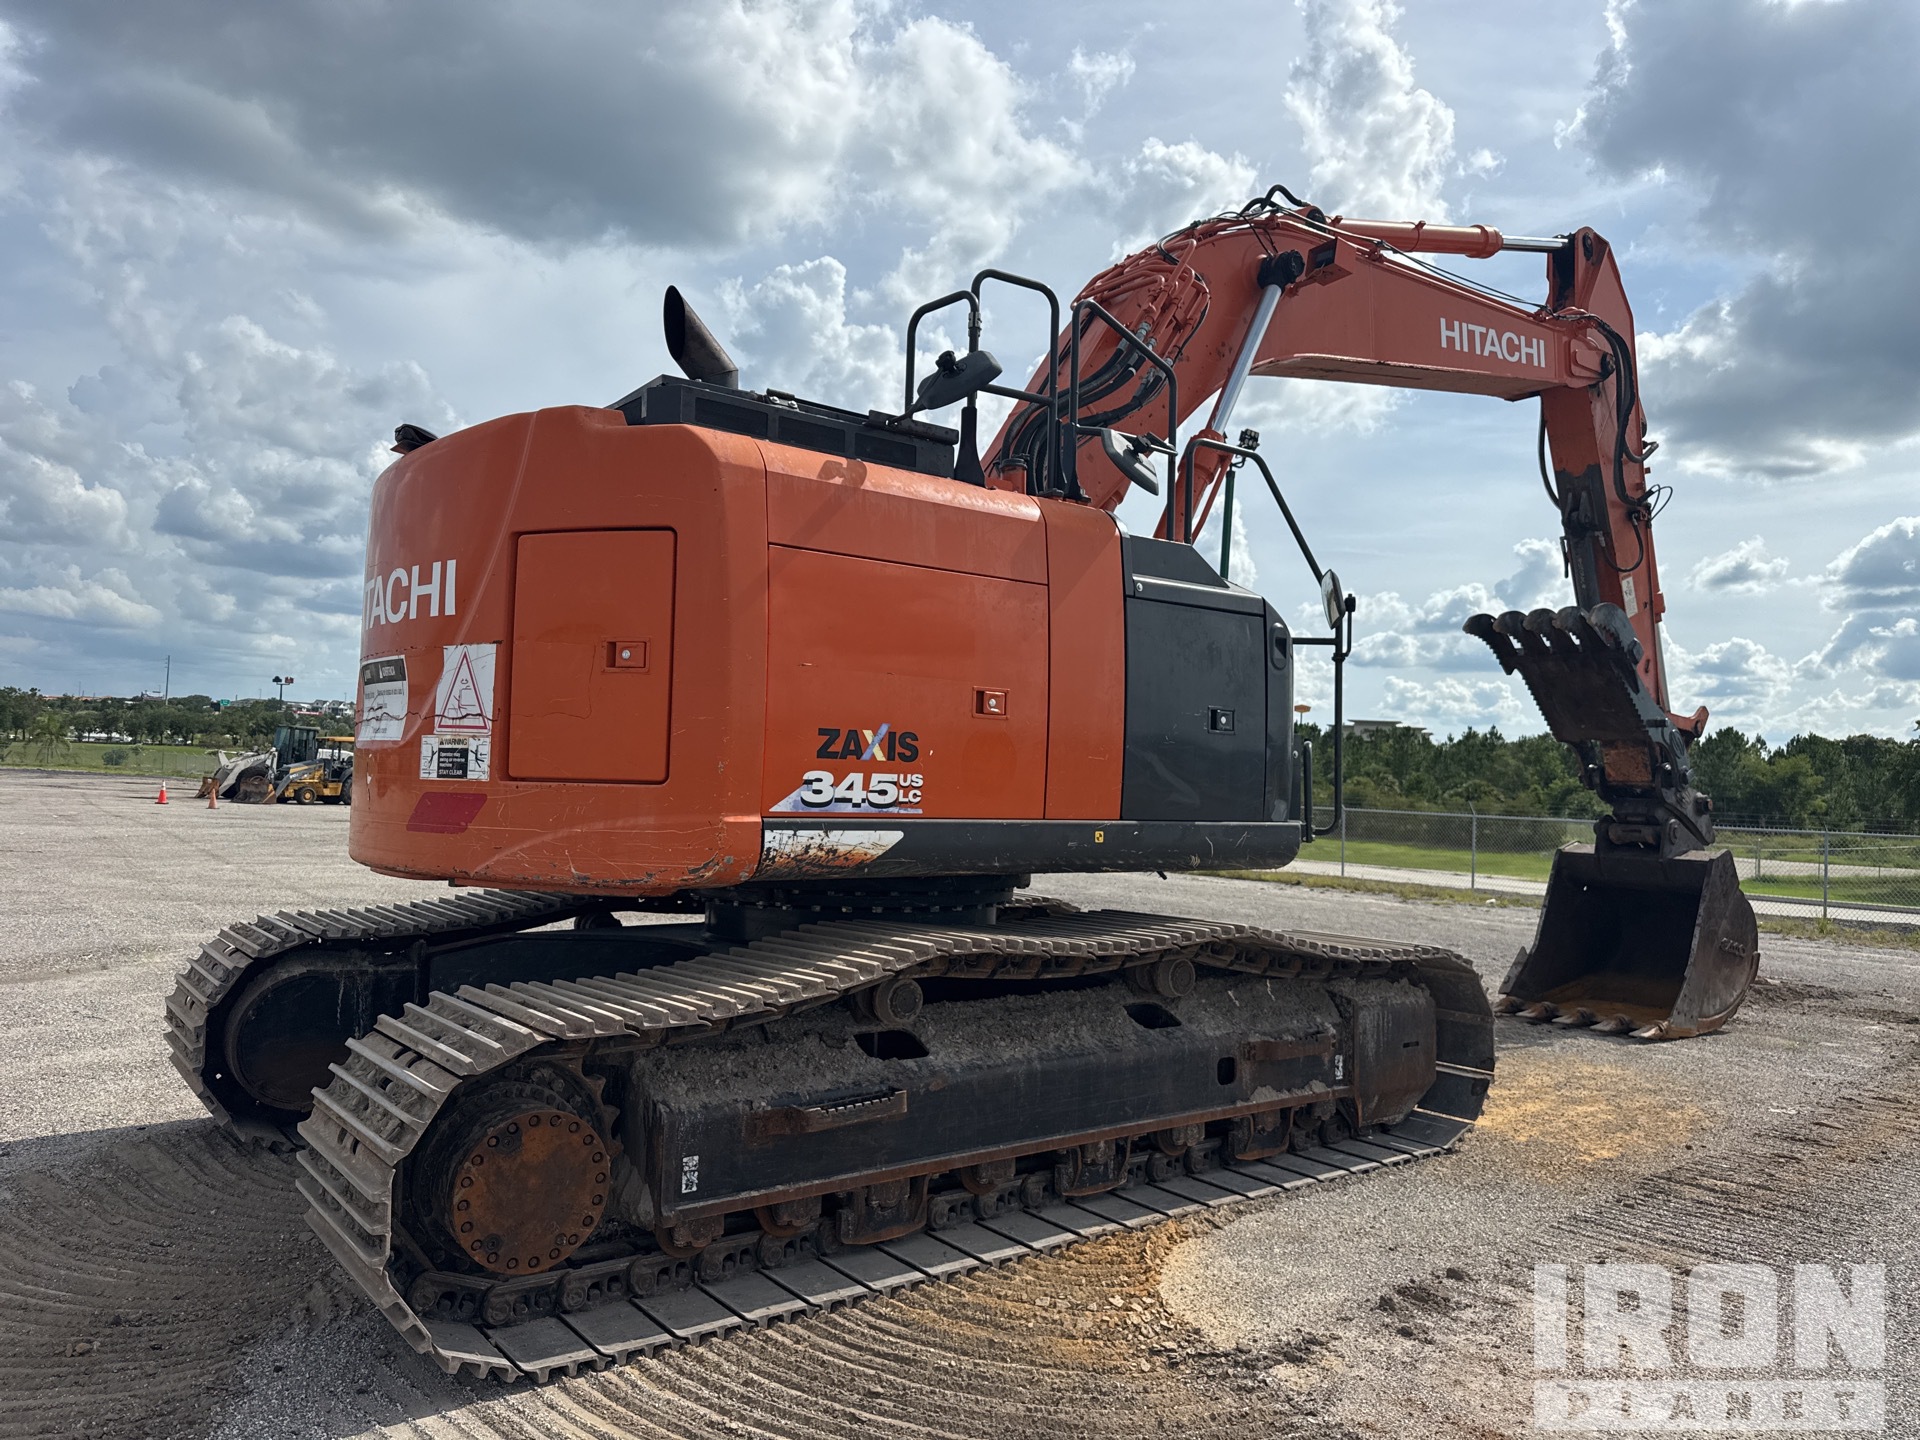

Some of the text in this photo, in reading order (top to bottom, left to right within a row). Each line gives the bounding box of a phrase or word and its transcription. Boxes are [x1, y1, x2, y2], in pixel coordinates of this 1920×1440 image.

[1440, 317, 1546, 369] HITACHI
[363, 559, 457, 630] TACHI
[444, 738, 467, 746] WARNING
[816, 723, 919, 763] ZAXIS
[800, 770, 899, 808] 345
[898, 789, 922, 804] LC
[899, 773, 924, 788] US
